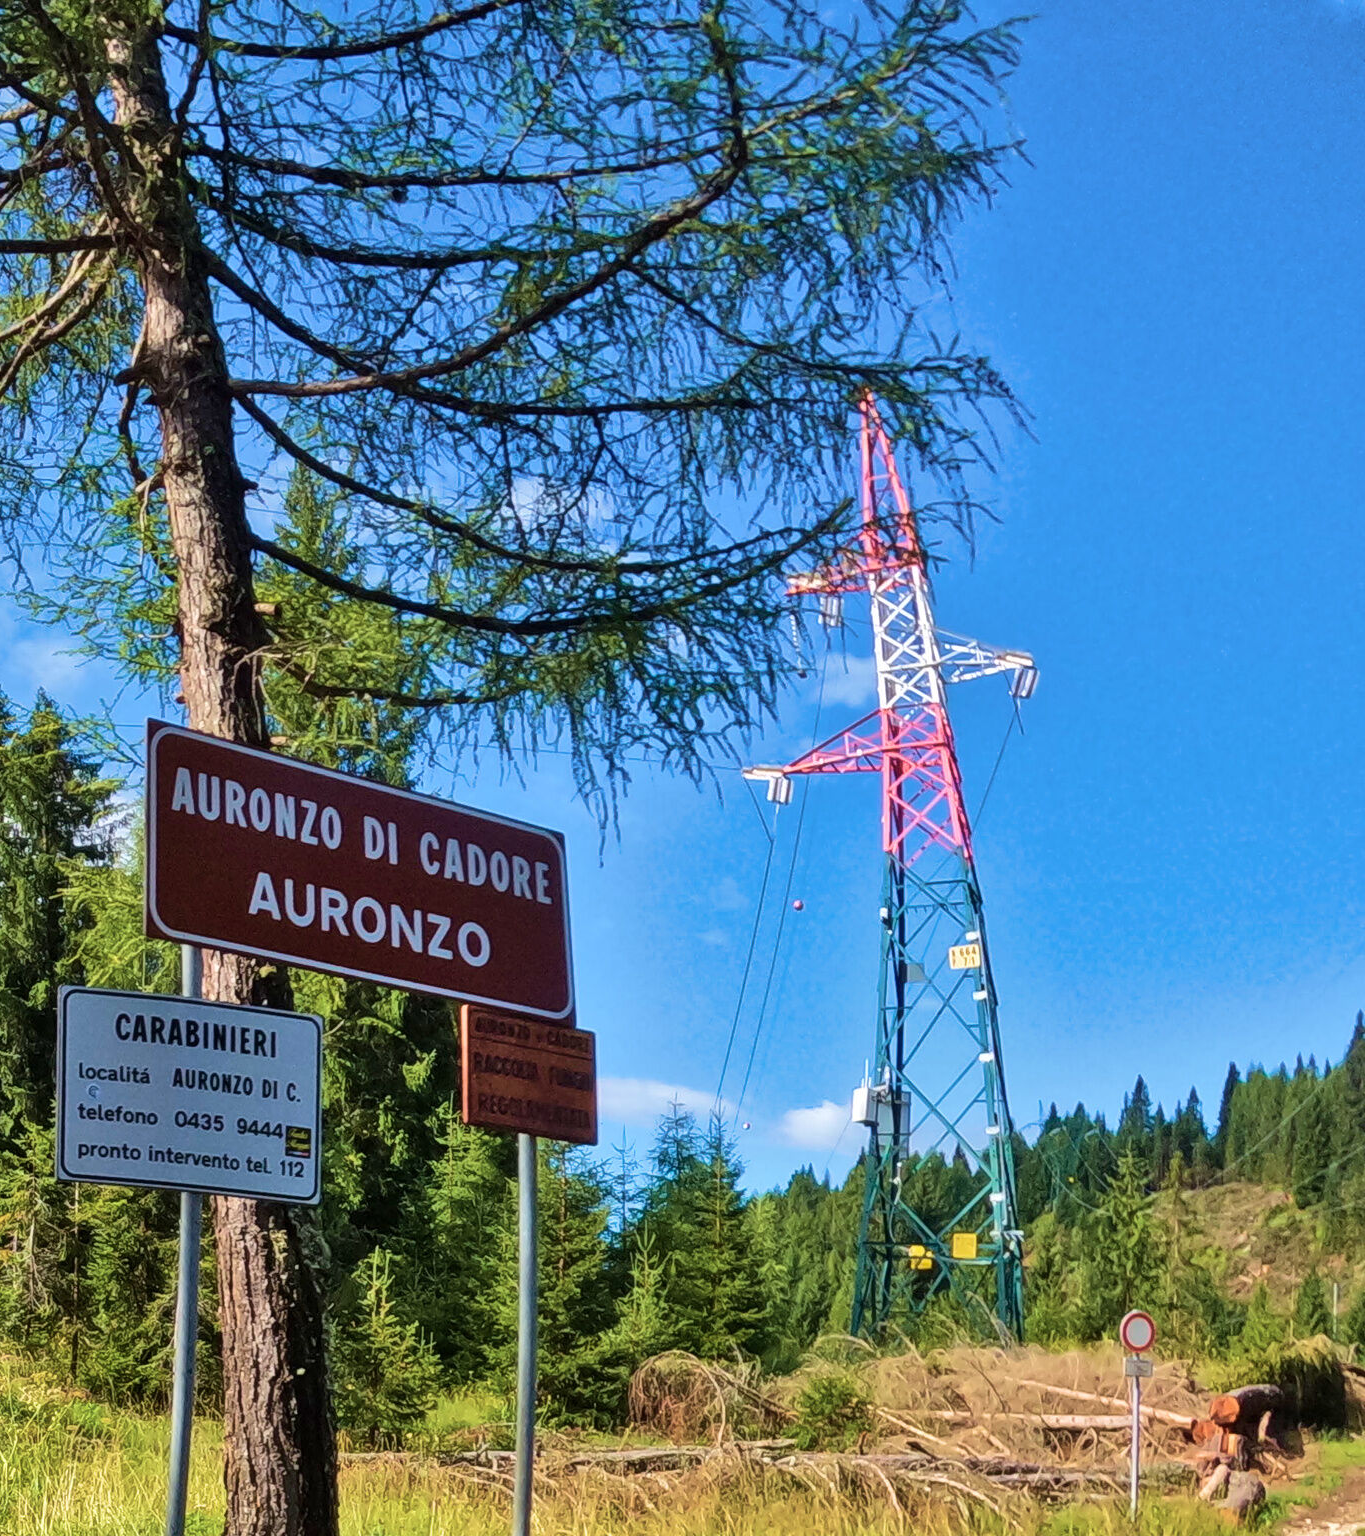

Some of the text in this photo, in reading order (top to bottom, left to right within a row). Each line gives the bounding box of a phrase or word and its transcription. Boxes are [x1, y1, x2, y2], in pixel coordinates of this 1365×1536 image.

[171, 767, 553, 905] AURONZO DI CADORE
[248, 871, 491, 968] AURONZO
[115, 1012, 277, 1059] CARABINIERI
[172, 1067, 253, 1096] AURONZO
[262, 1078, 278, 1100] DI
[286, 1082, 301, 1103] C.
[77, 1103, 158, 1126] telefono
[174, 1110, 225, 1132] 0435
[236, 1118, 284, 1139] 9444
[77, 1143, 305, 1178] pronto intervento tel. 112
